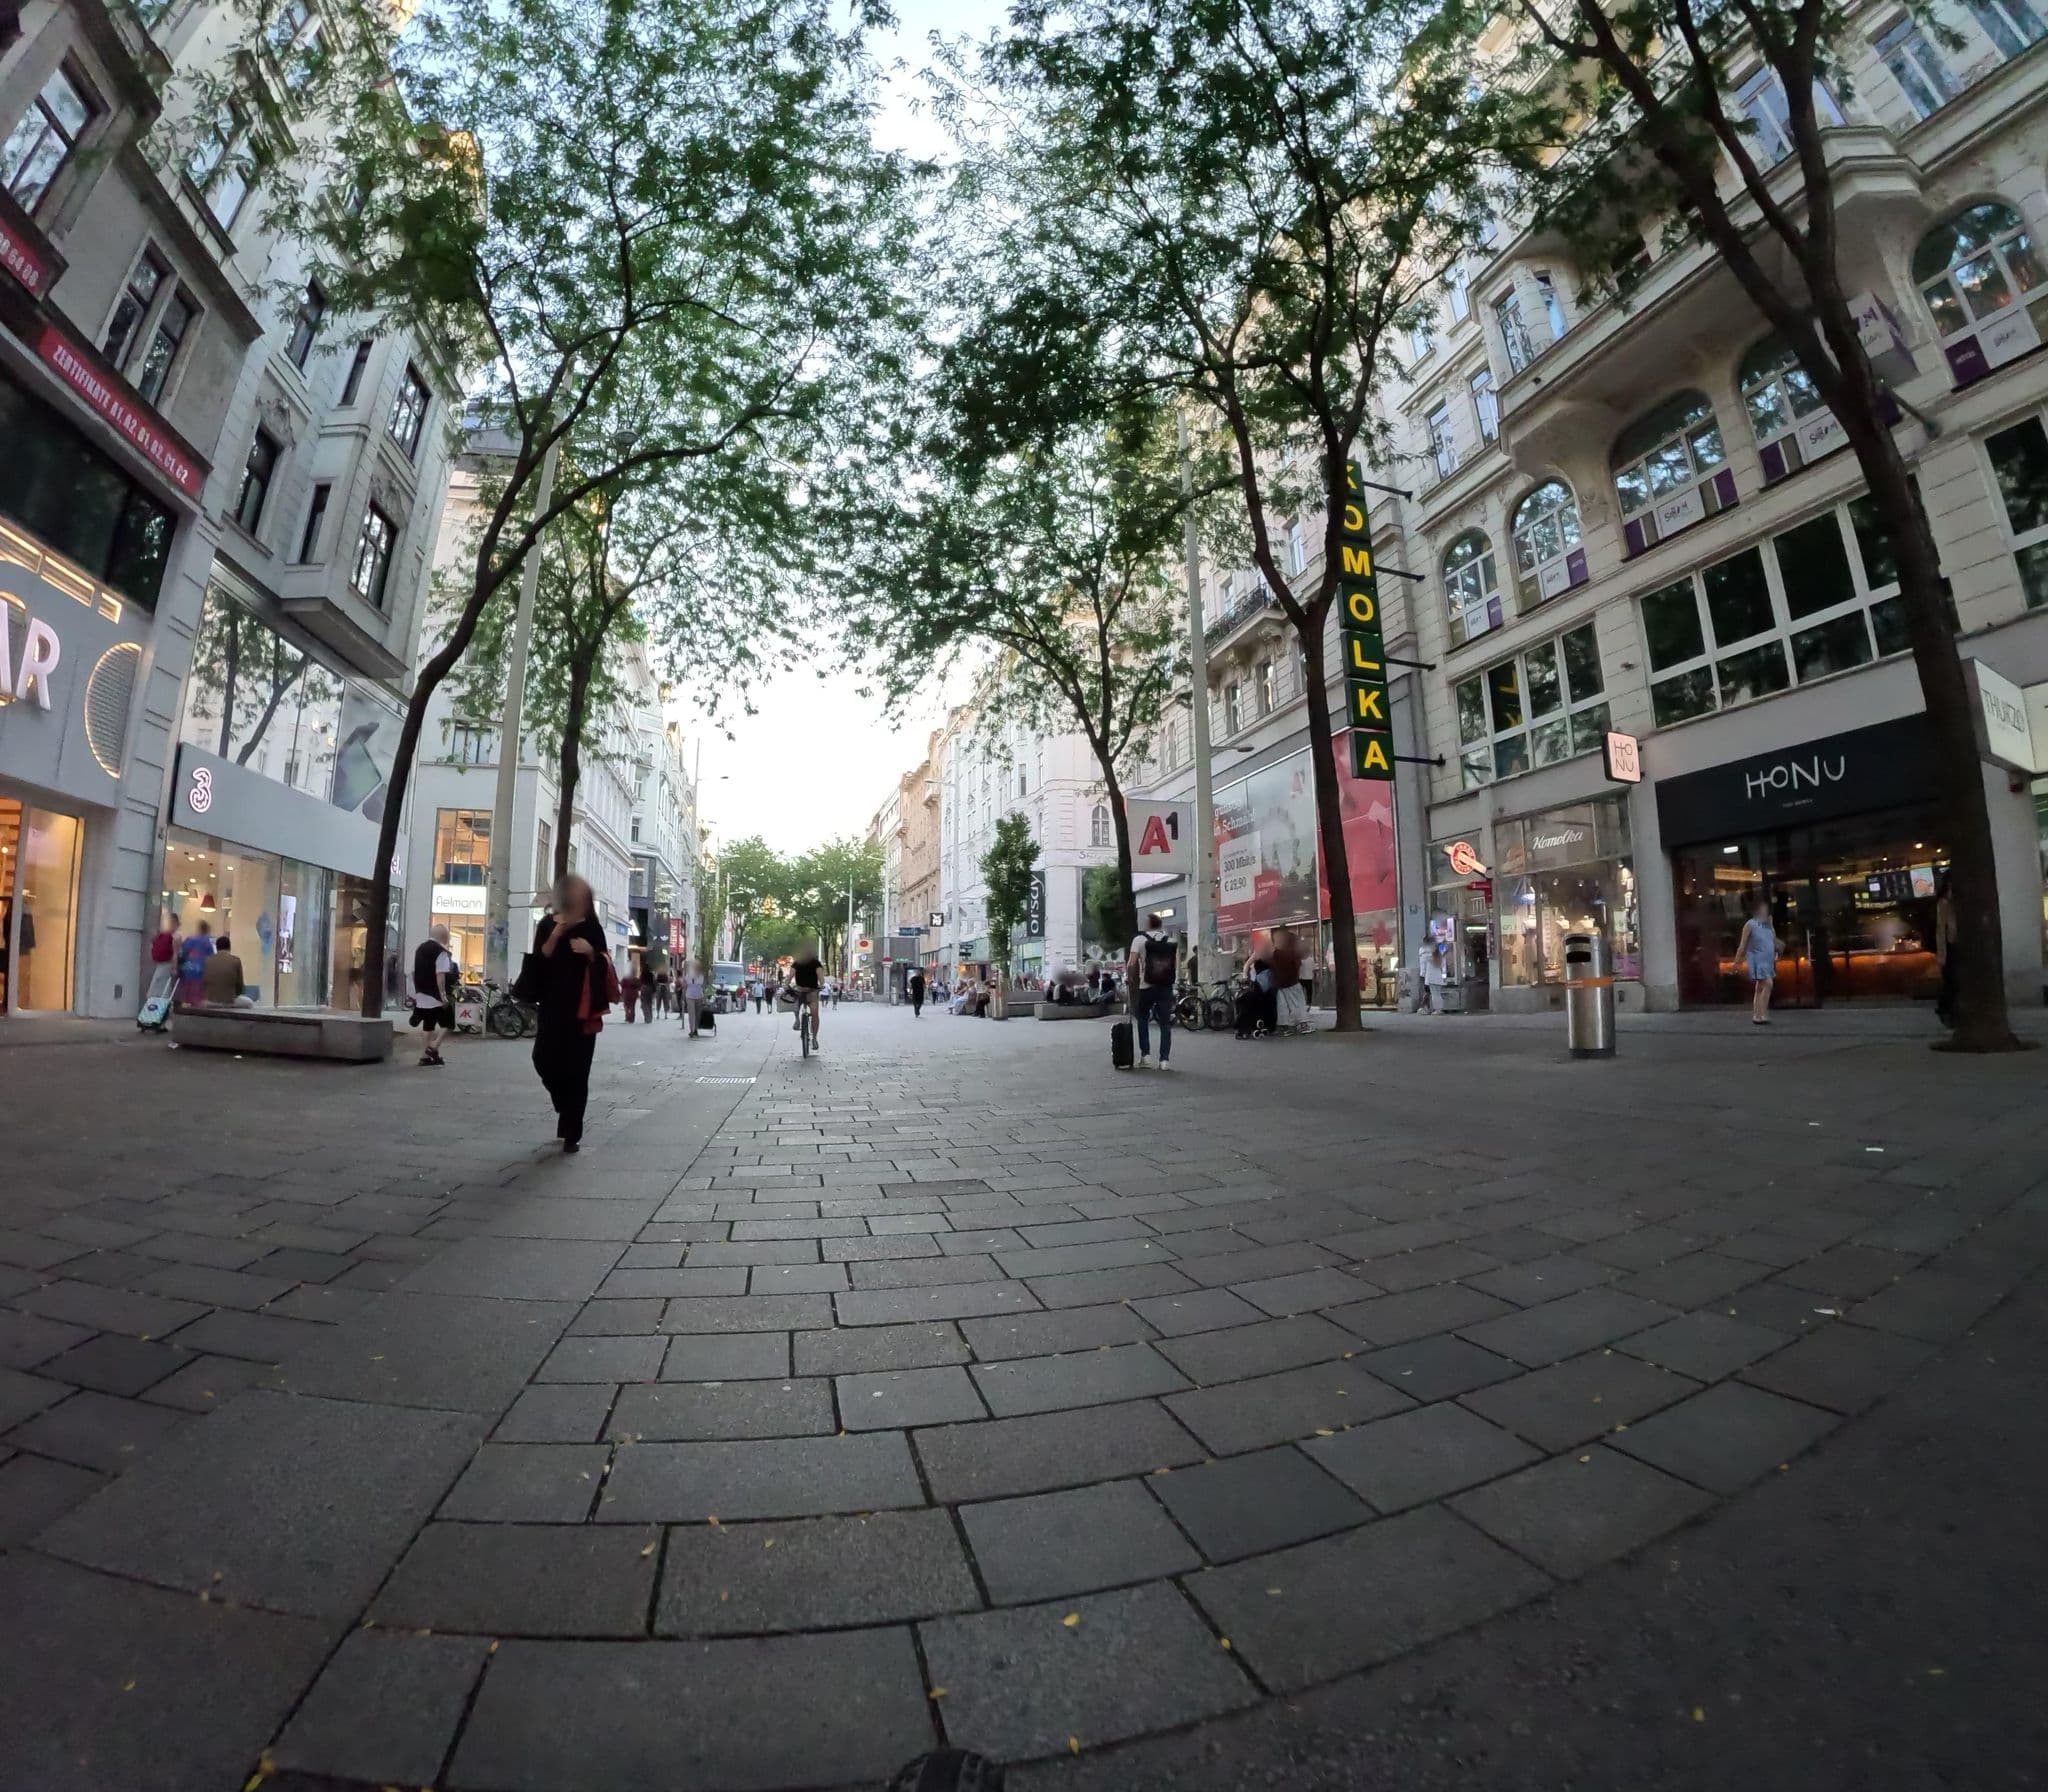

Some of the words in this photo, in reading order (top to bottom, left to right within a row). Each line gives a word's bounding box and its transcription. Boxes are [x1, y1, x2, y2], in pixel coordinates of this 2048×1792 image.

[53, 345, 111, 409] ZERTIFIKATE
[175, 464, 189, 484] C2
[190, 767, 212, 813] 3
[1745, 755, 1846, 799] HONU
[1138, 811, 1179, 856] A1
[1533, 829, 1583, 850] Komolka
[1224, 859, 1236, 873] 300
[436, 896, 482, 909] fielmann
[1030, 874, 1045, 934] orsay
